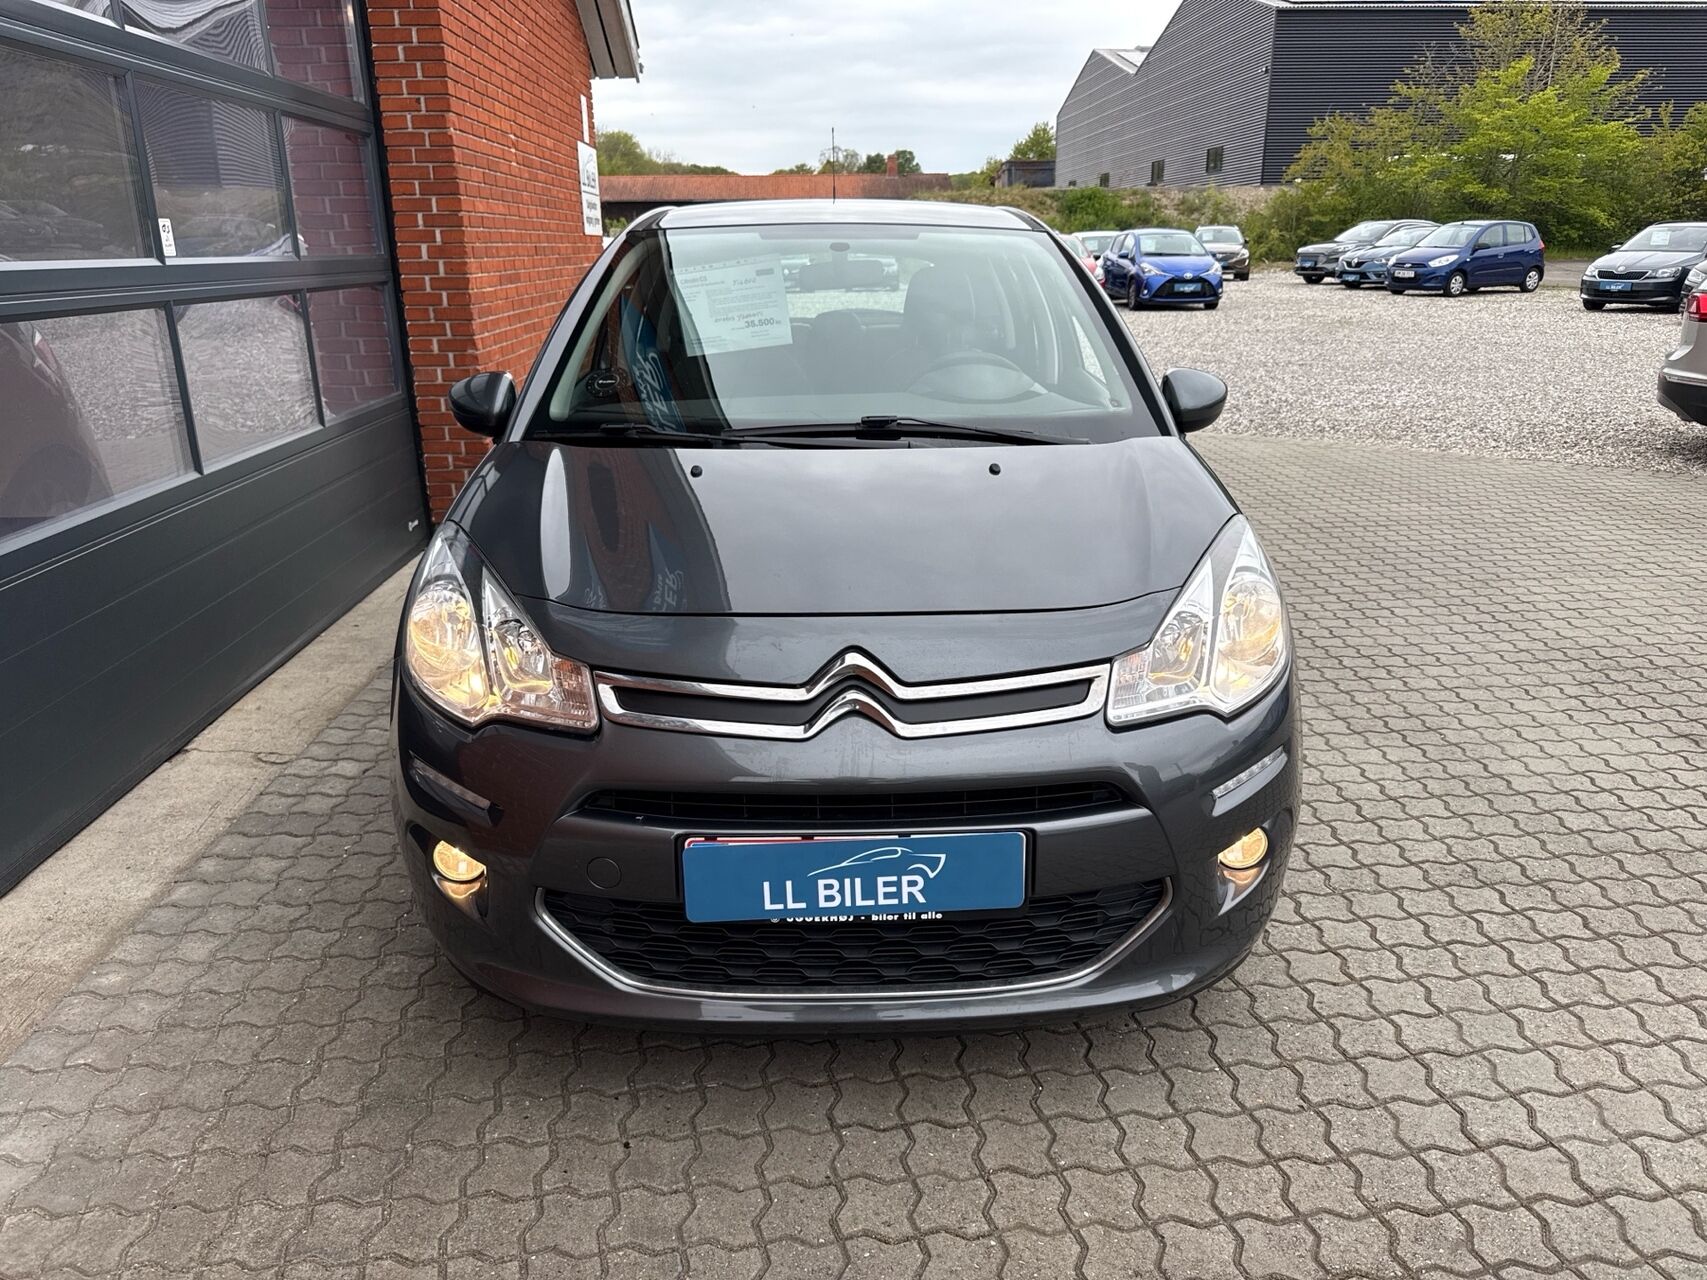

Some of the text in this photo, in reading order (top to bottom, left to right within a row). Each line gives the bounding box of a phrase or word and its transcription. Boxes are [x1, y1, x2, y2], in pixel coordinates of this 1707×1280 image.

[763, 874, 927, 911] LL BILER
[871, 913, 899, 921] biler
[903, 912, 916, 920] til
[920, 911, 943, 920] alle
